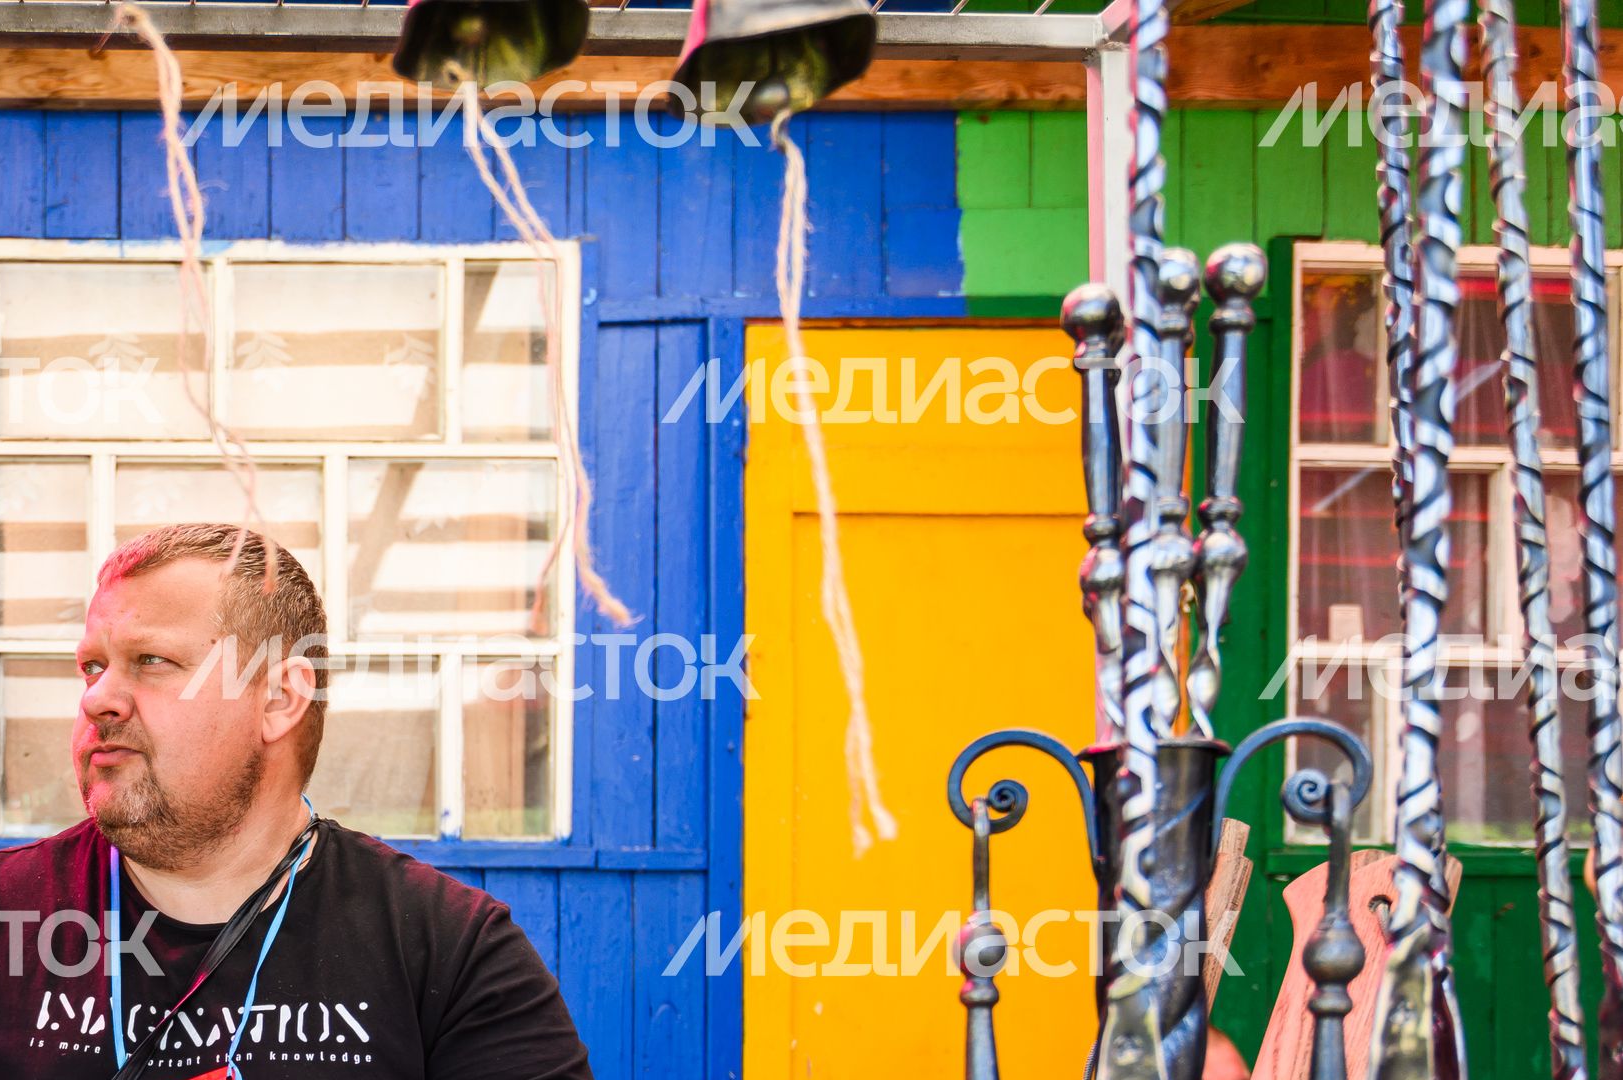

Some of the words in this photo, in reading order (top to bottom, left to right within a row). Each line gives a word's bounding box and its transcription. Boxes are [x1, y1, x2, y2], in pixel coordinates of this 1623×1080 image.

[29, 1037, 45, 1048] is
[59, 1041, 101, 1054] more
[269, 1050, 372, 1064] knowledge
